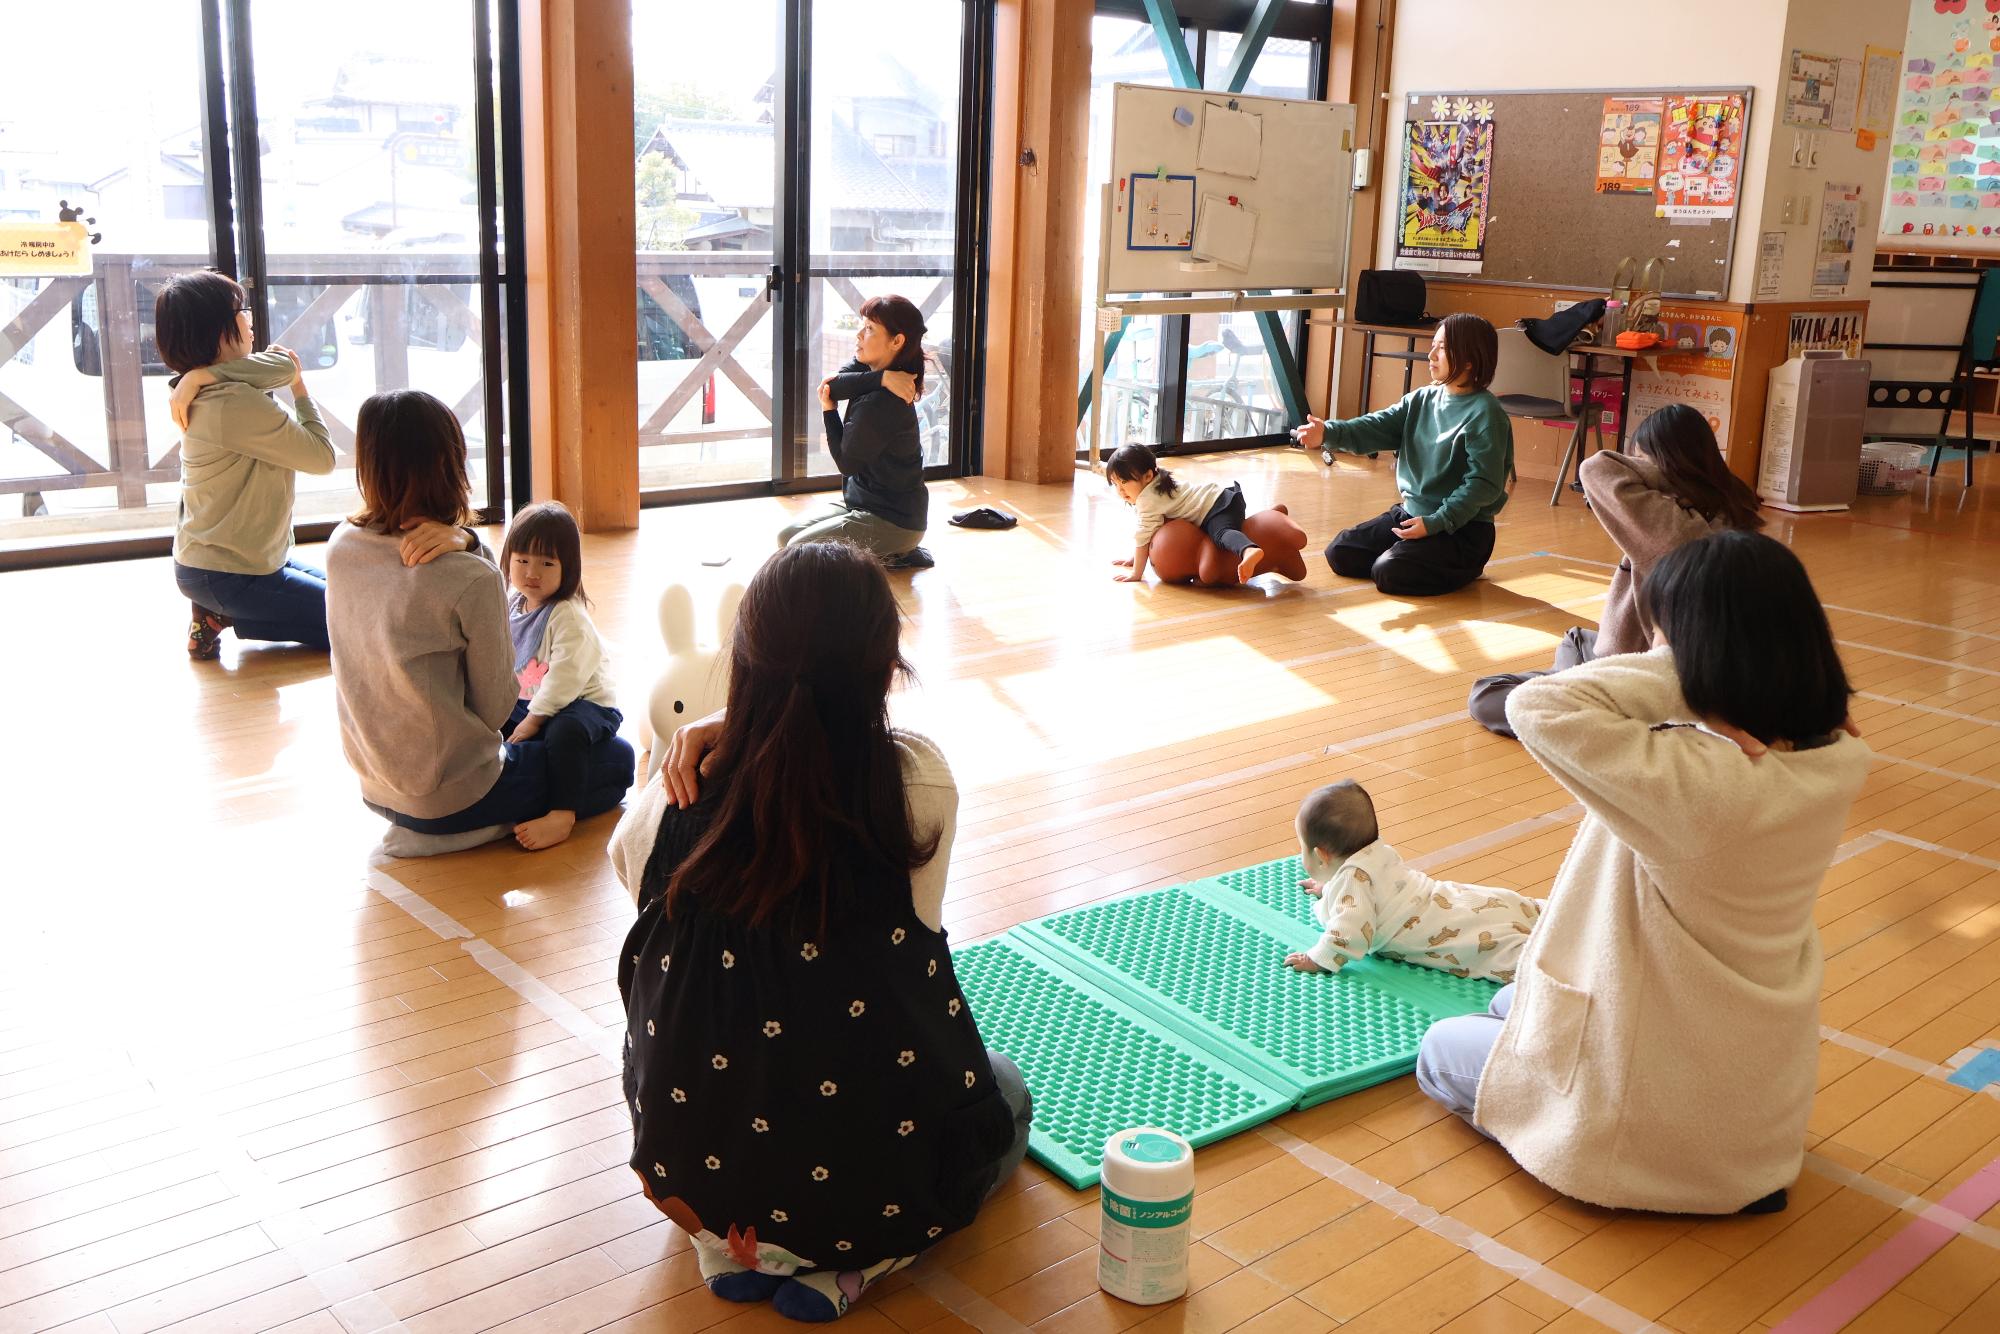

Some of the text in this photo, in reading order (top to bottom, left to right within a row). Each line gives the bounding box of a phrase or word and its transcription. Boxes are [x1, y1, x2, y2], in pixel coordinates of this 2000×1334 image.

[1625, 104, 1640, 112] 189
[1603, 182, 1621, 191] 189
[1791, 316, 1860, 345] WIN ALL
[1109, 1198, 1131, 1218] 除菌
